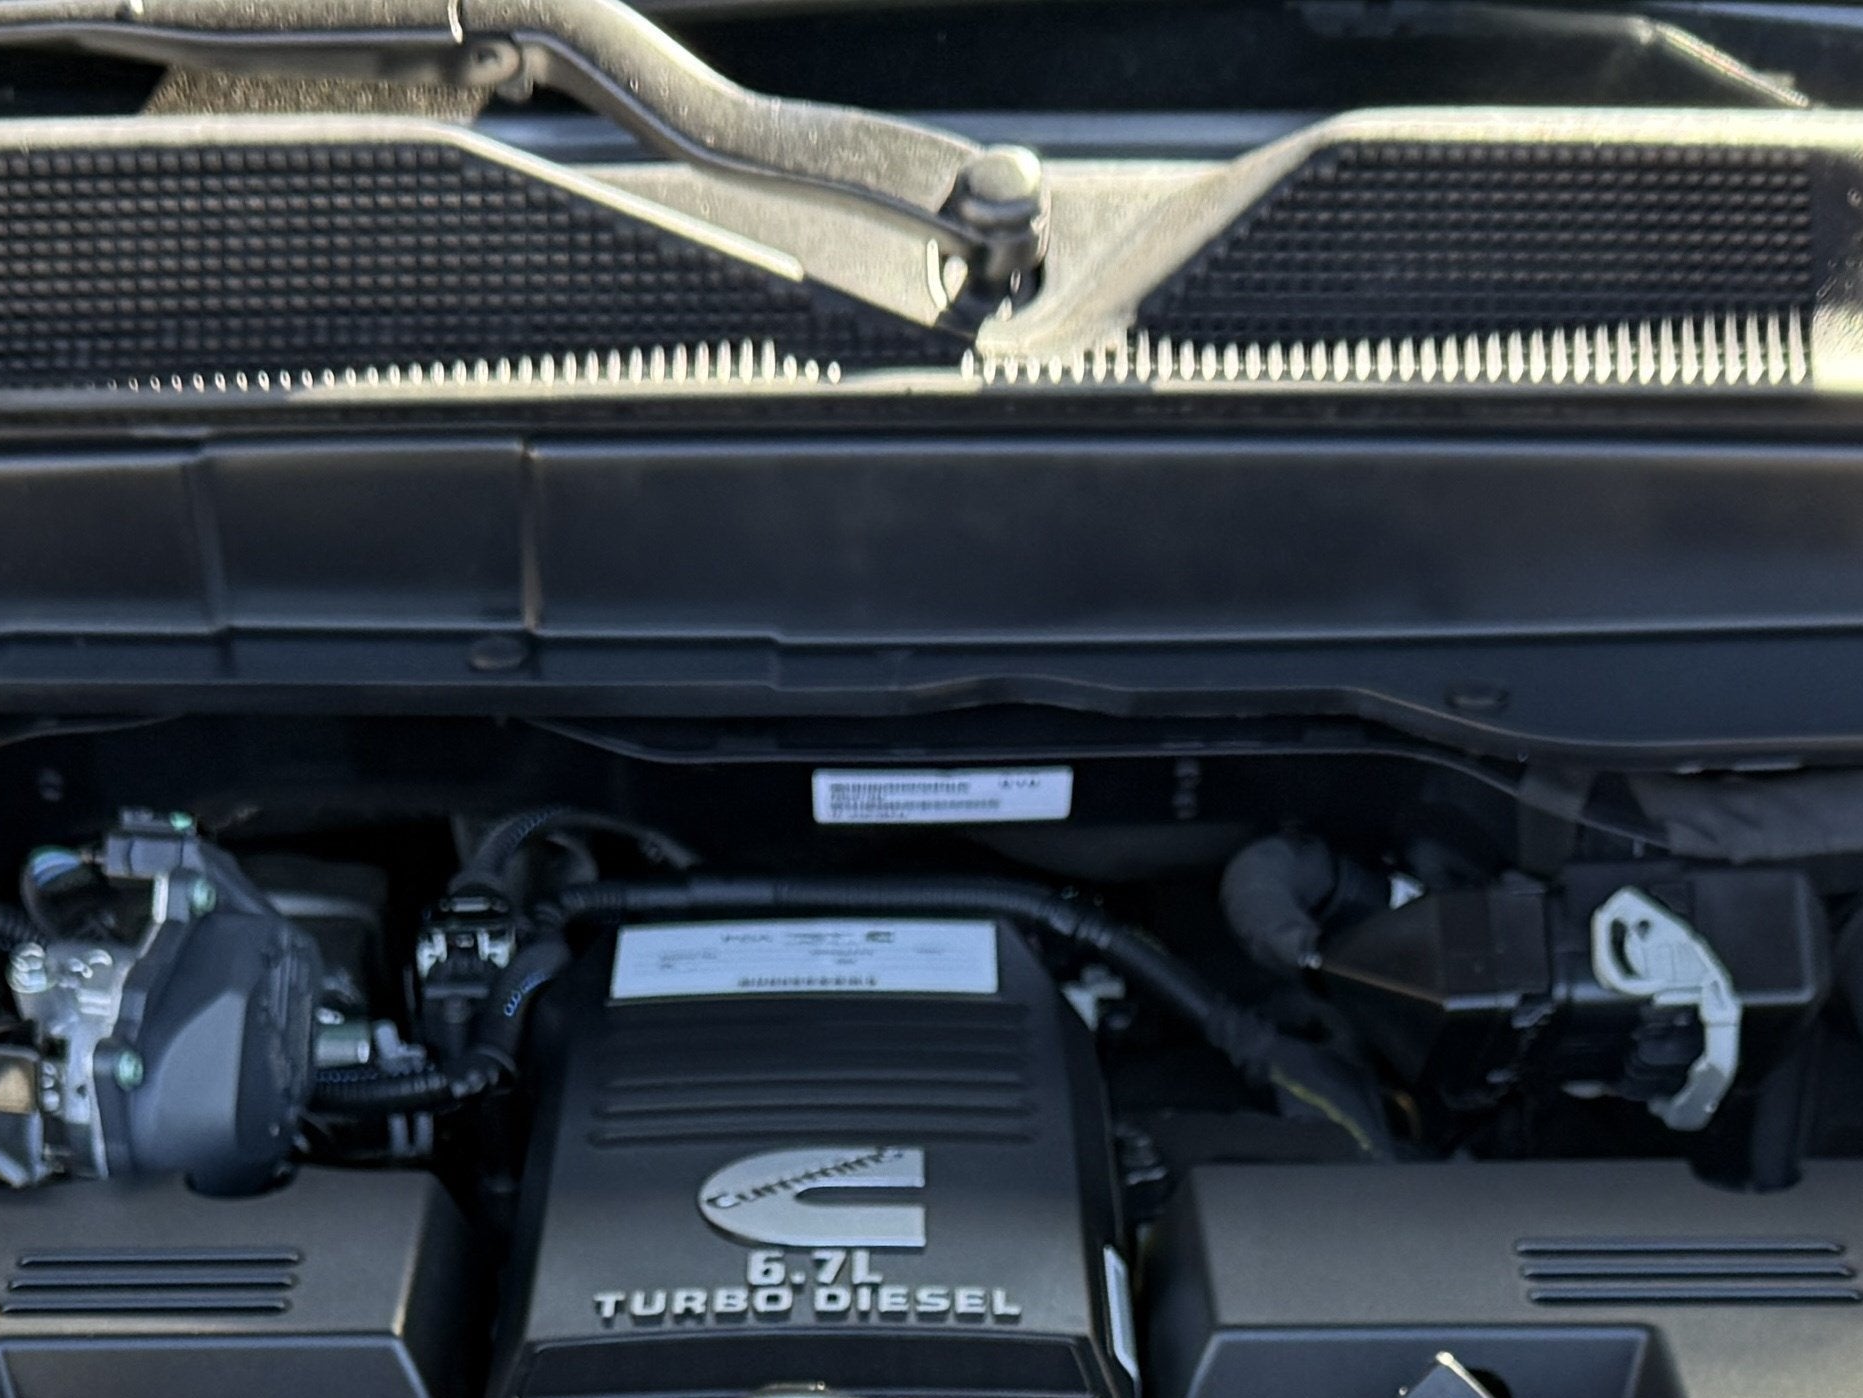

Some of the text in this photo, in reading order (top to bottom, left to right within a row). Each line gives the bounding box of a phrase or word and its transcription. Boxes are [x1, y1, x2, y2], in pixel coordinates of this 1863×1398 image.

[747, 1249, 883, 1287] 6.7L
[593, 1284, 1023, 1325] TURBO DIESEL
